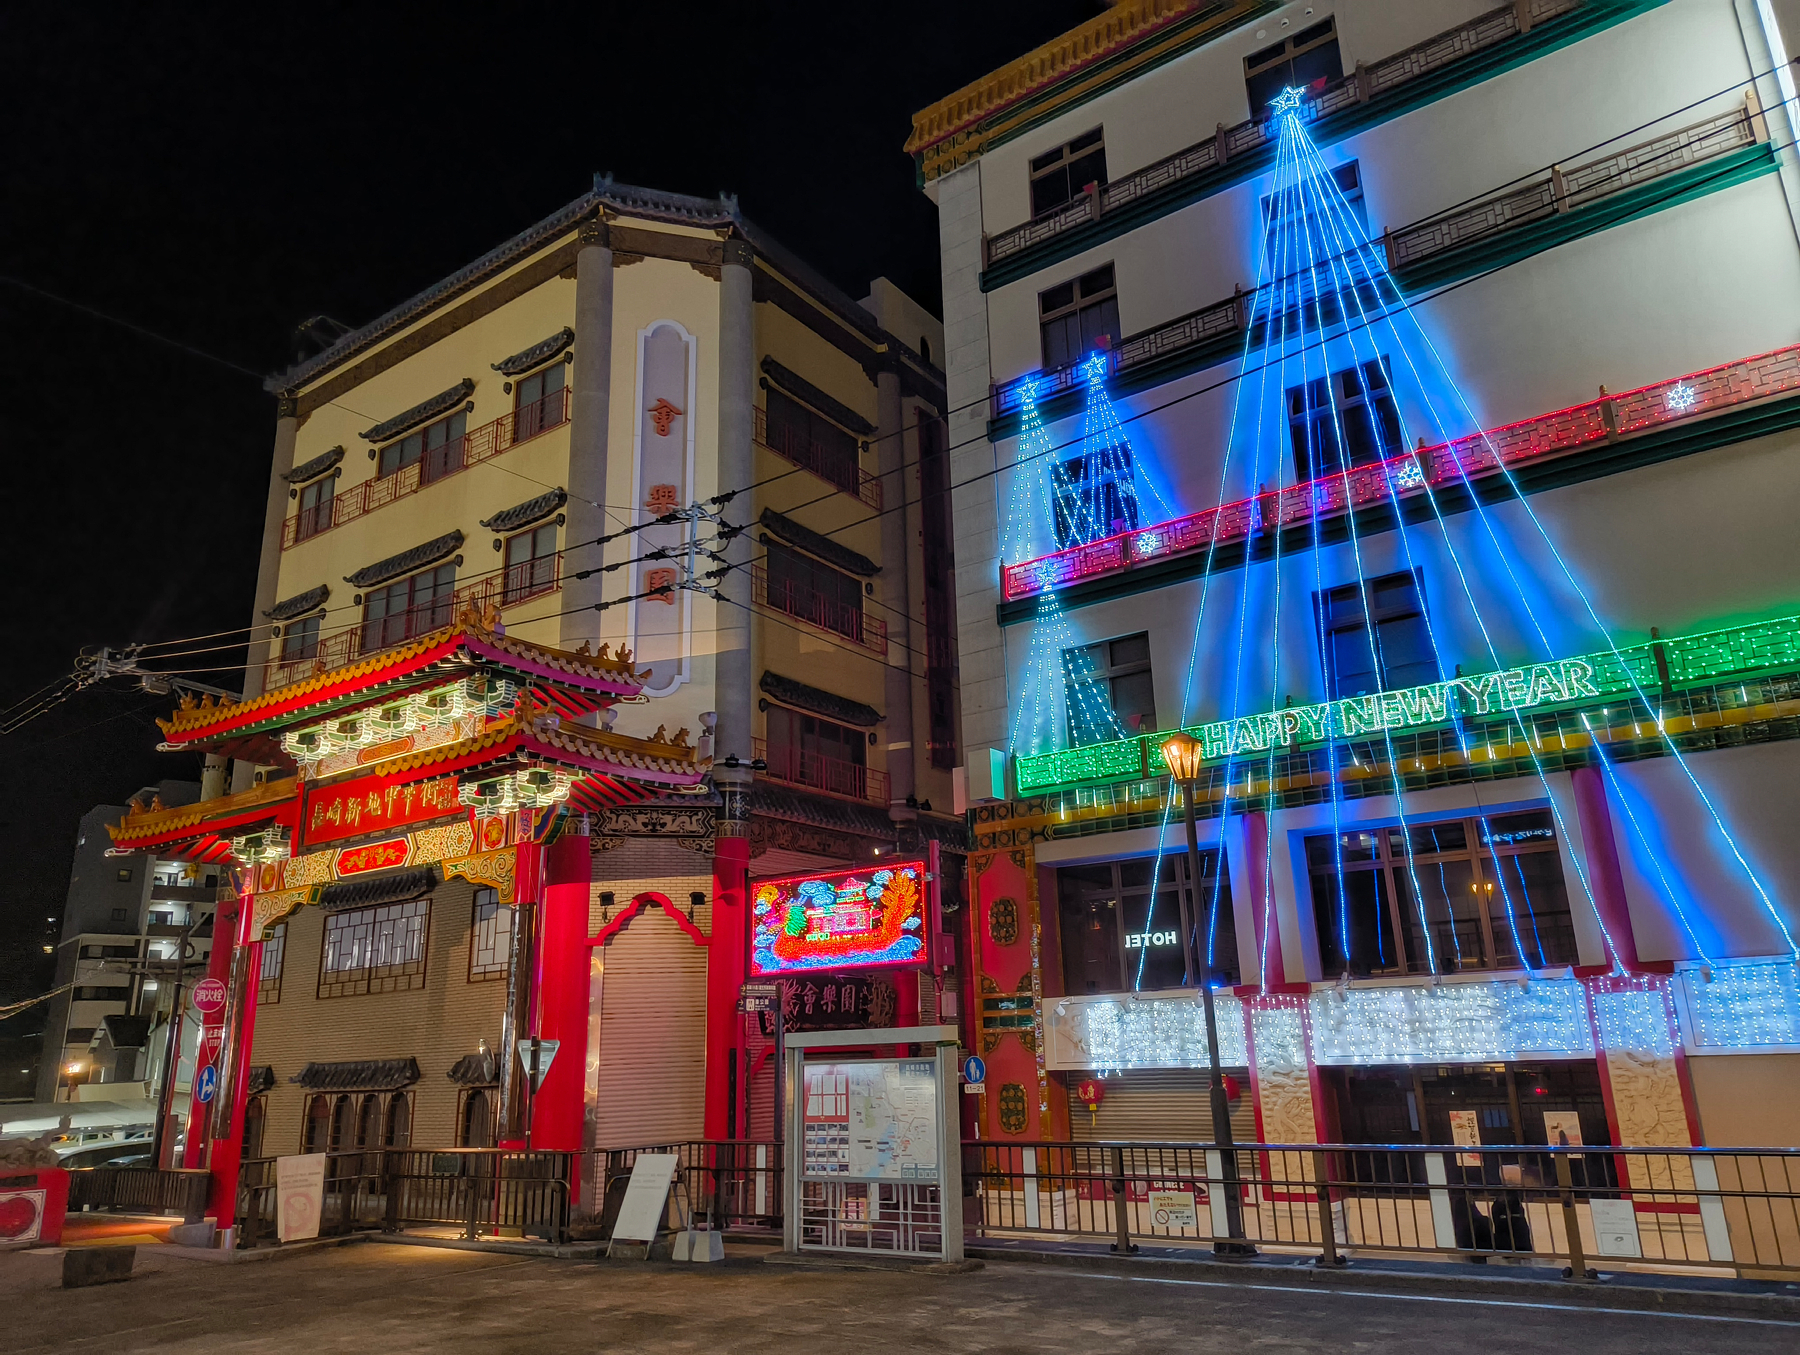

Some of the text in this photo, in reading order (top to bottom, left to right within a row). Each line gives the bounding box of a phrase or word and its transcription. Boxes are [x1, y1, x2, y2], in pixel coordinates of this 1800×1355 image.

[1203, 660, 1600, 758] HAPPY NEW YEAR
[196, 988, 223, 1002] 消火栓
[801, 981, 856, 1015] 會樂園
